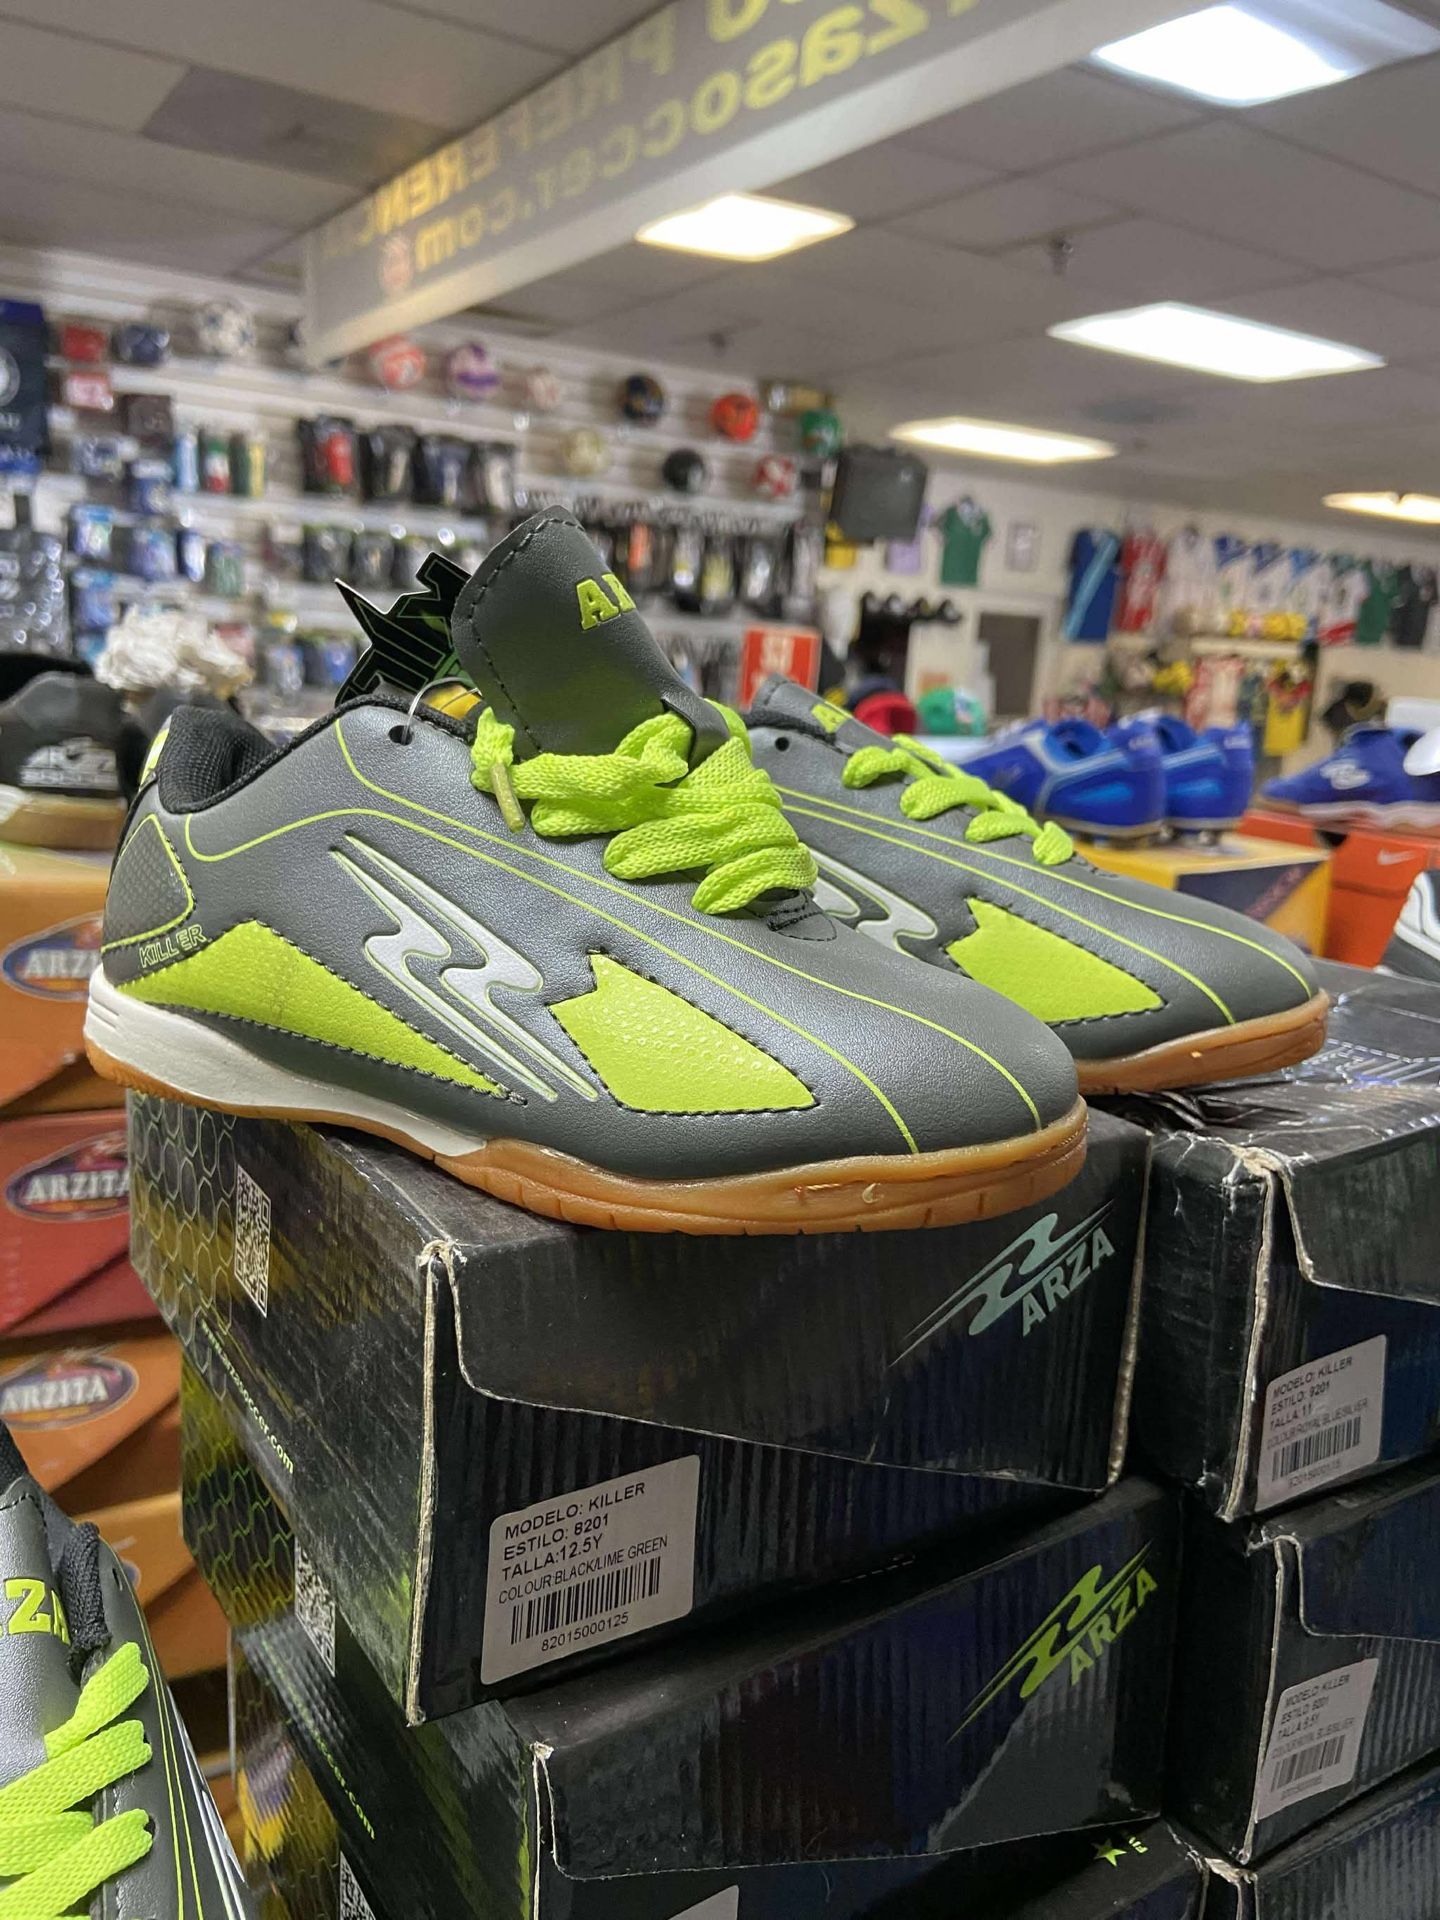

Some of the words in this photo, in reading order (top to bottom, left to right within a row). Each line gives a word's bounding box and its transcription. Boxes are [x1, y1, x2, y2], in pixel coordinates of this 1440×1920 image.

[24, 949, 101, 980] ARZI
[139, 924, 207, 968] KILLER
[1022, 1226, 1116, 1337] ARZA
[1318, 1356, 1353, 1379] KILLER
[505, 1504, 583, 1540] MODELO:
[588, 1482, 646, 1512] KILLER
[503, 1528, 569, 1561] ESTILO:
[574, 1513, 609, 1535] 8201
[627, 1535, 668, 1559] GREEN
[0, 1578, 71, 1647] ZA
[541, 1611, 628, 1651] 82015000125
[1069, 1567, 1158, 1687] ARZA
